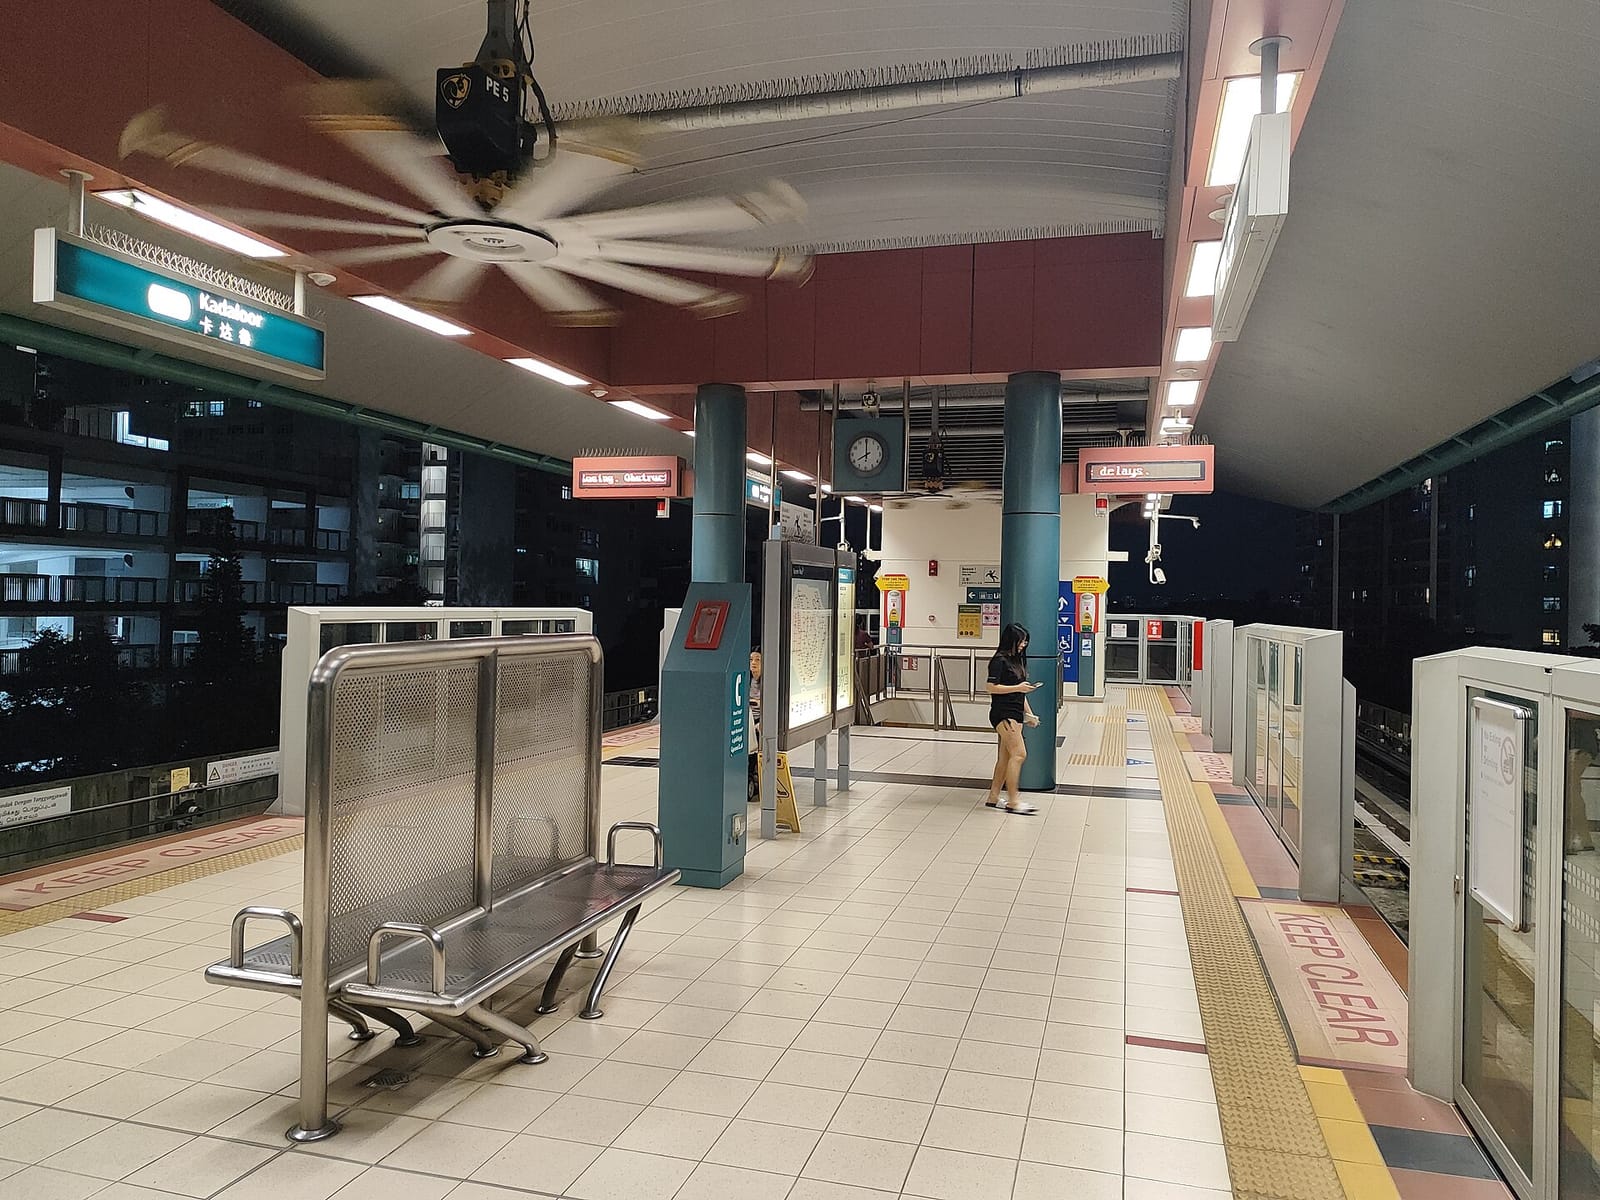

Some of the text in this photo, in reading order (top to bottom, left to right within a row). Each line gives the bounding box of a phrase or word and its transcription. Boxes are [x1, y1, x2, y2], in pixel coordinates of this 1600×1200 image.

[486, 76, 509, 103] PE 5
[199, 292, 265, 328] Kadaloor
[1099, 466, 1150, 478] delays.
[14, 823, 297, 895] KEEP CLEAR
[1274, 911, 1399, 1047] KEEP CLEAR
